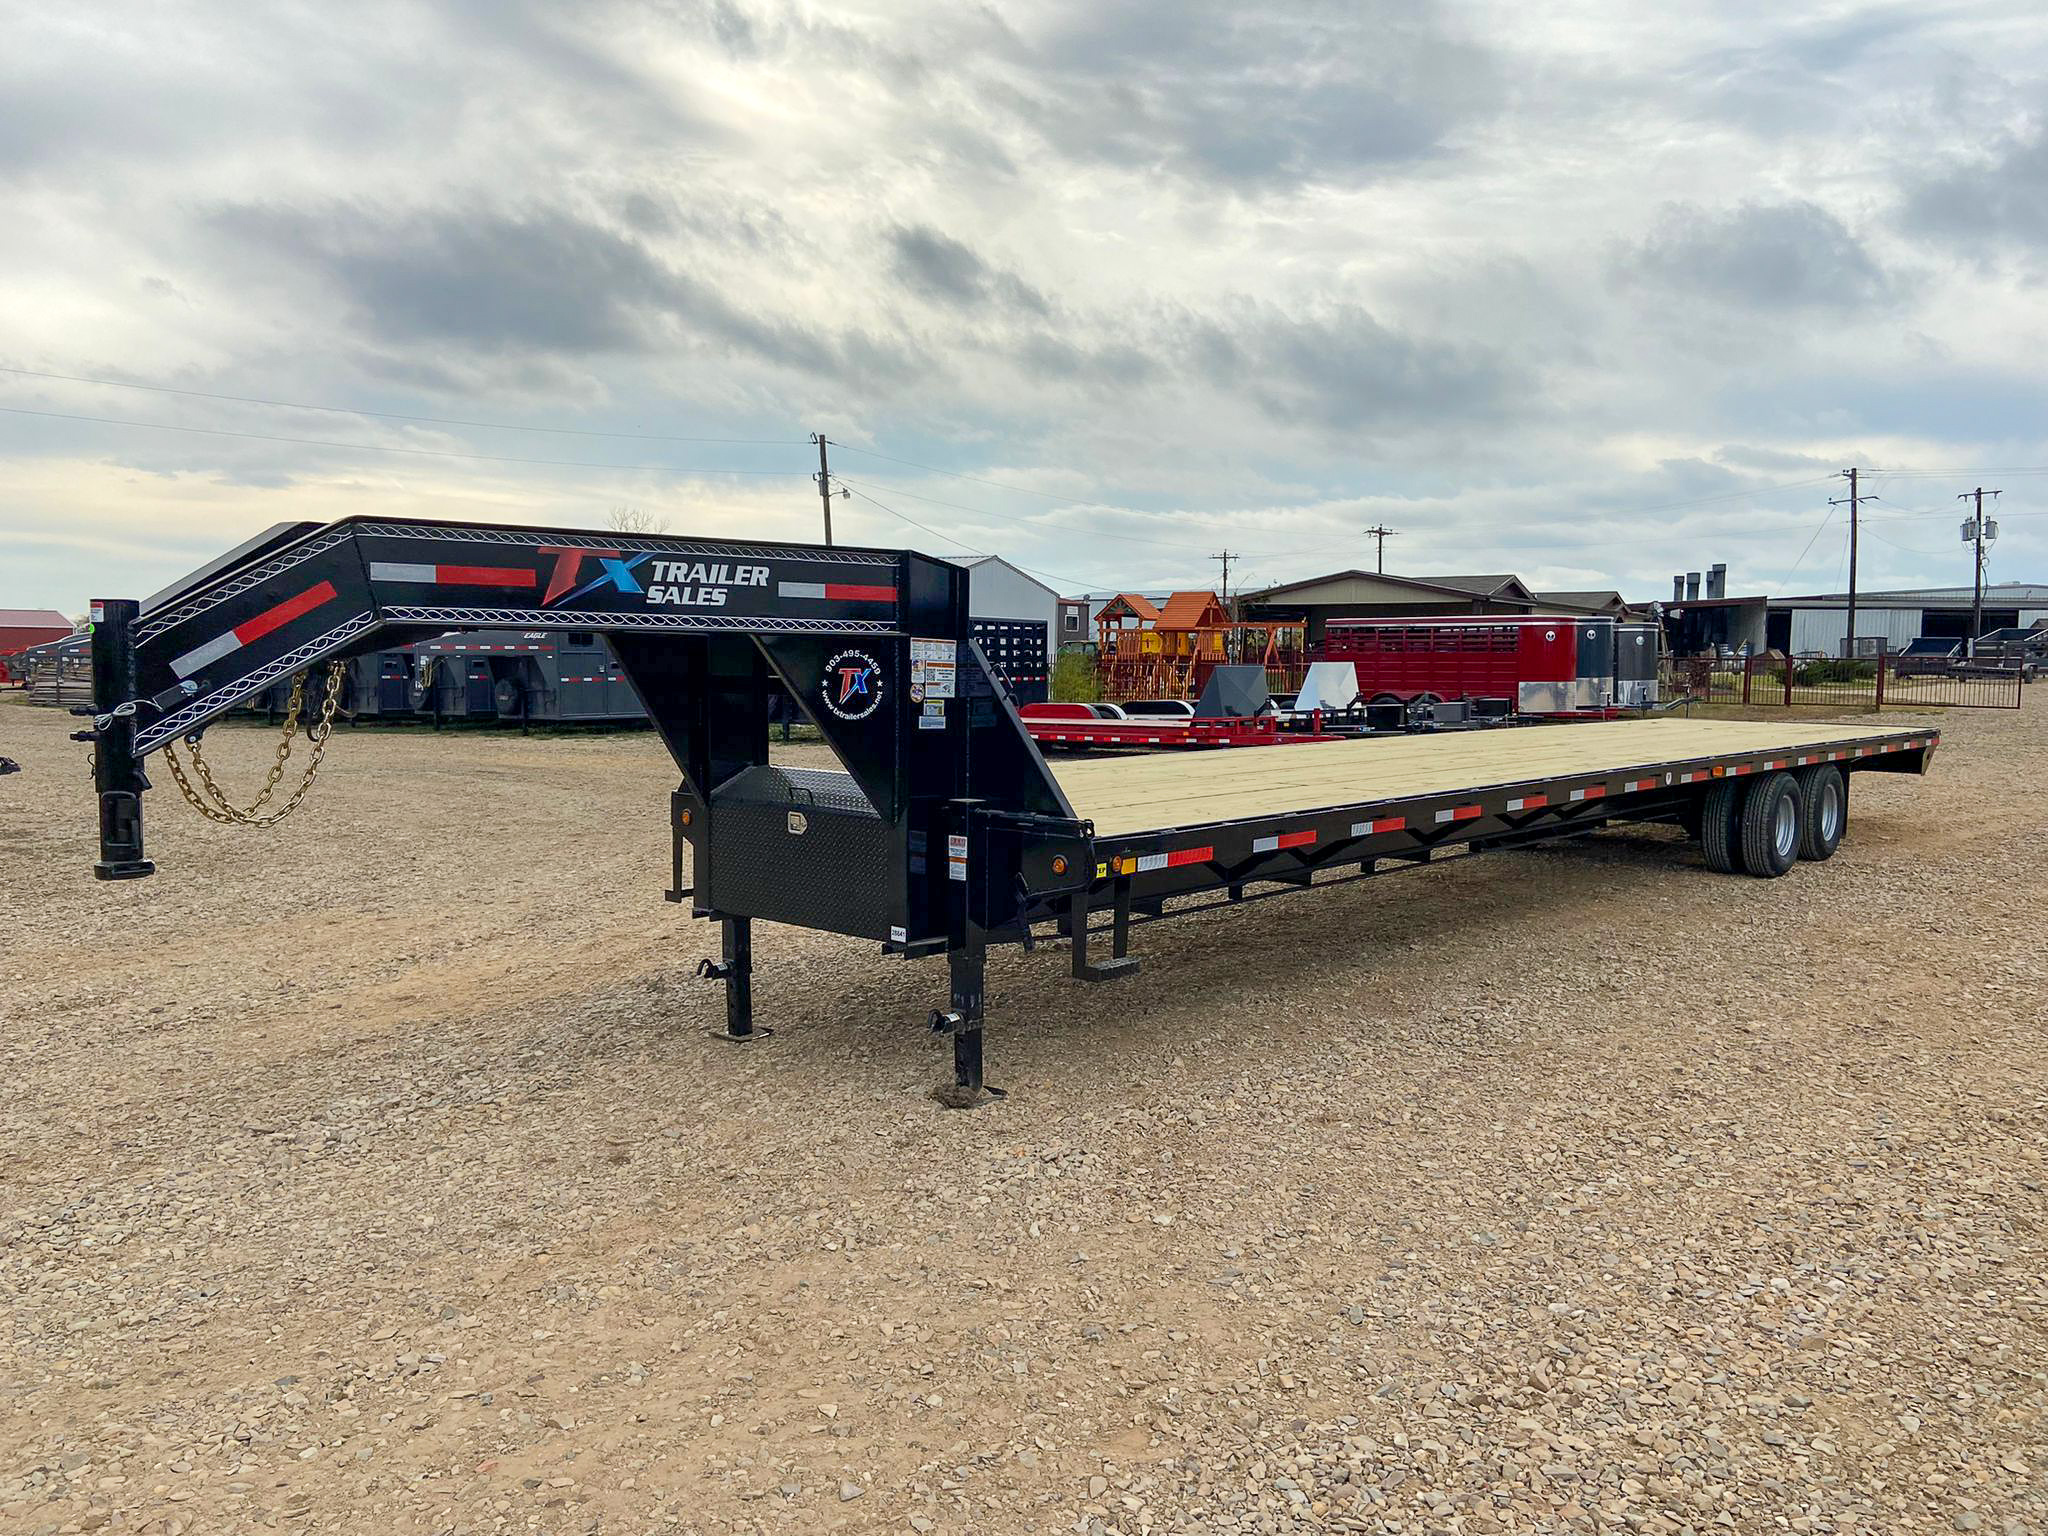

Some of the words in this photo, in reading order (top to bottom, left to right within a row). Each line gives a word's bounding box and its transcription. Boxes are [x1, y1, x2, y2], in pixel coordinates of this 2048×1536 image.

[538, 546, 657, 608] TX
[651, 560, 770, 587] TRAILER
[646, 586, 728, 606] SALES
[838, 667, 872, 705] TX
